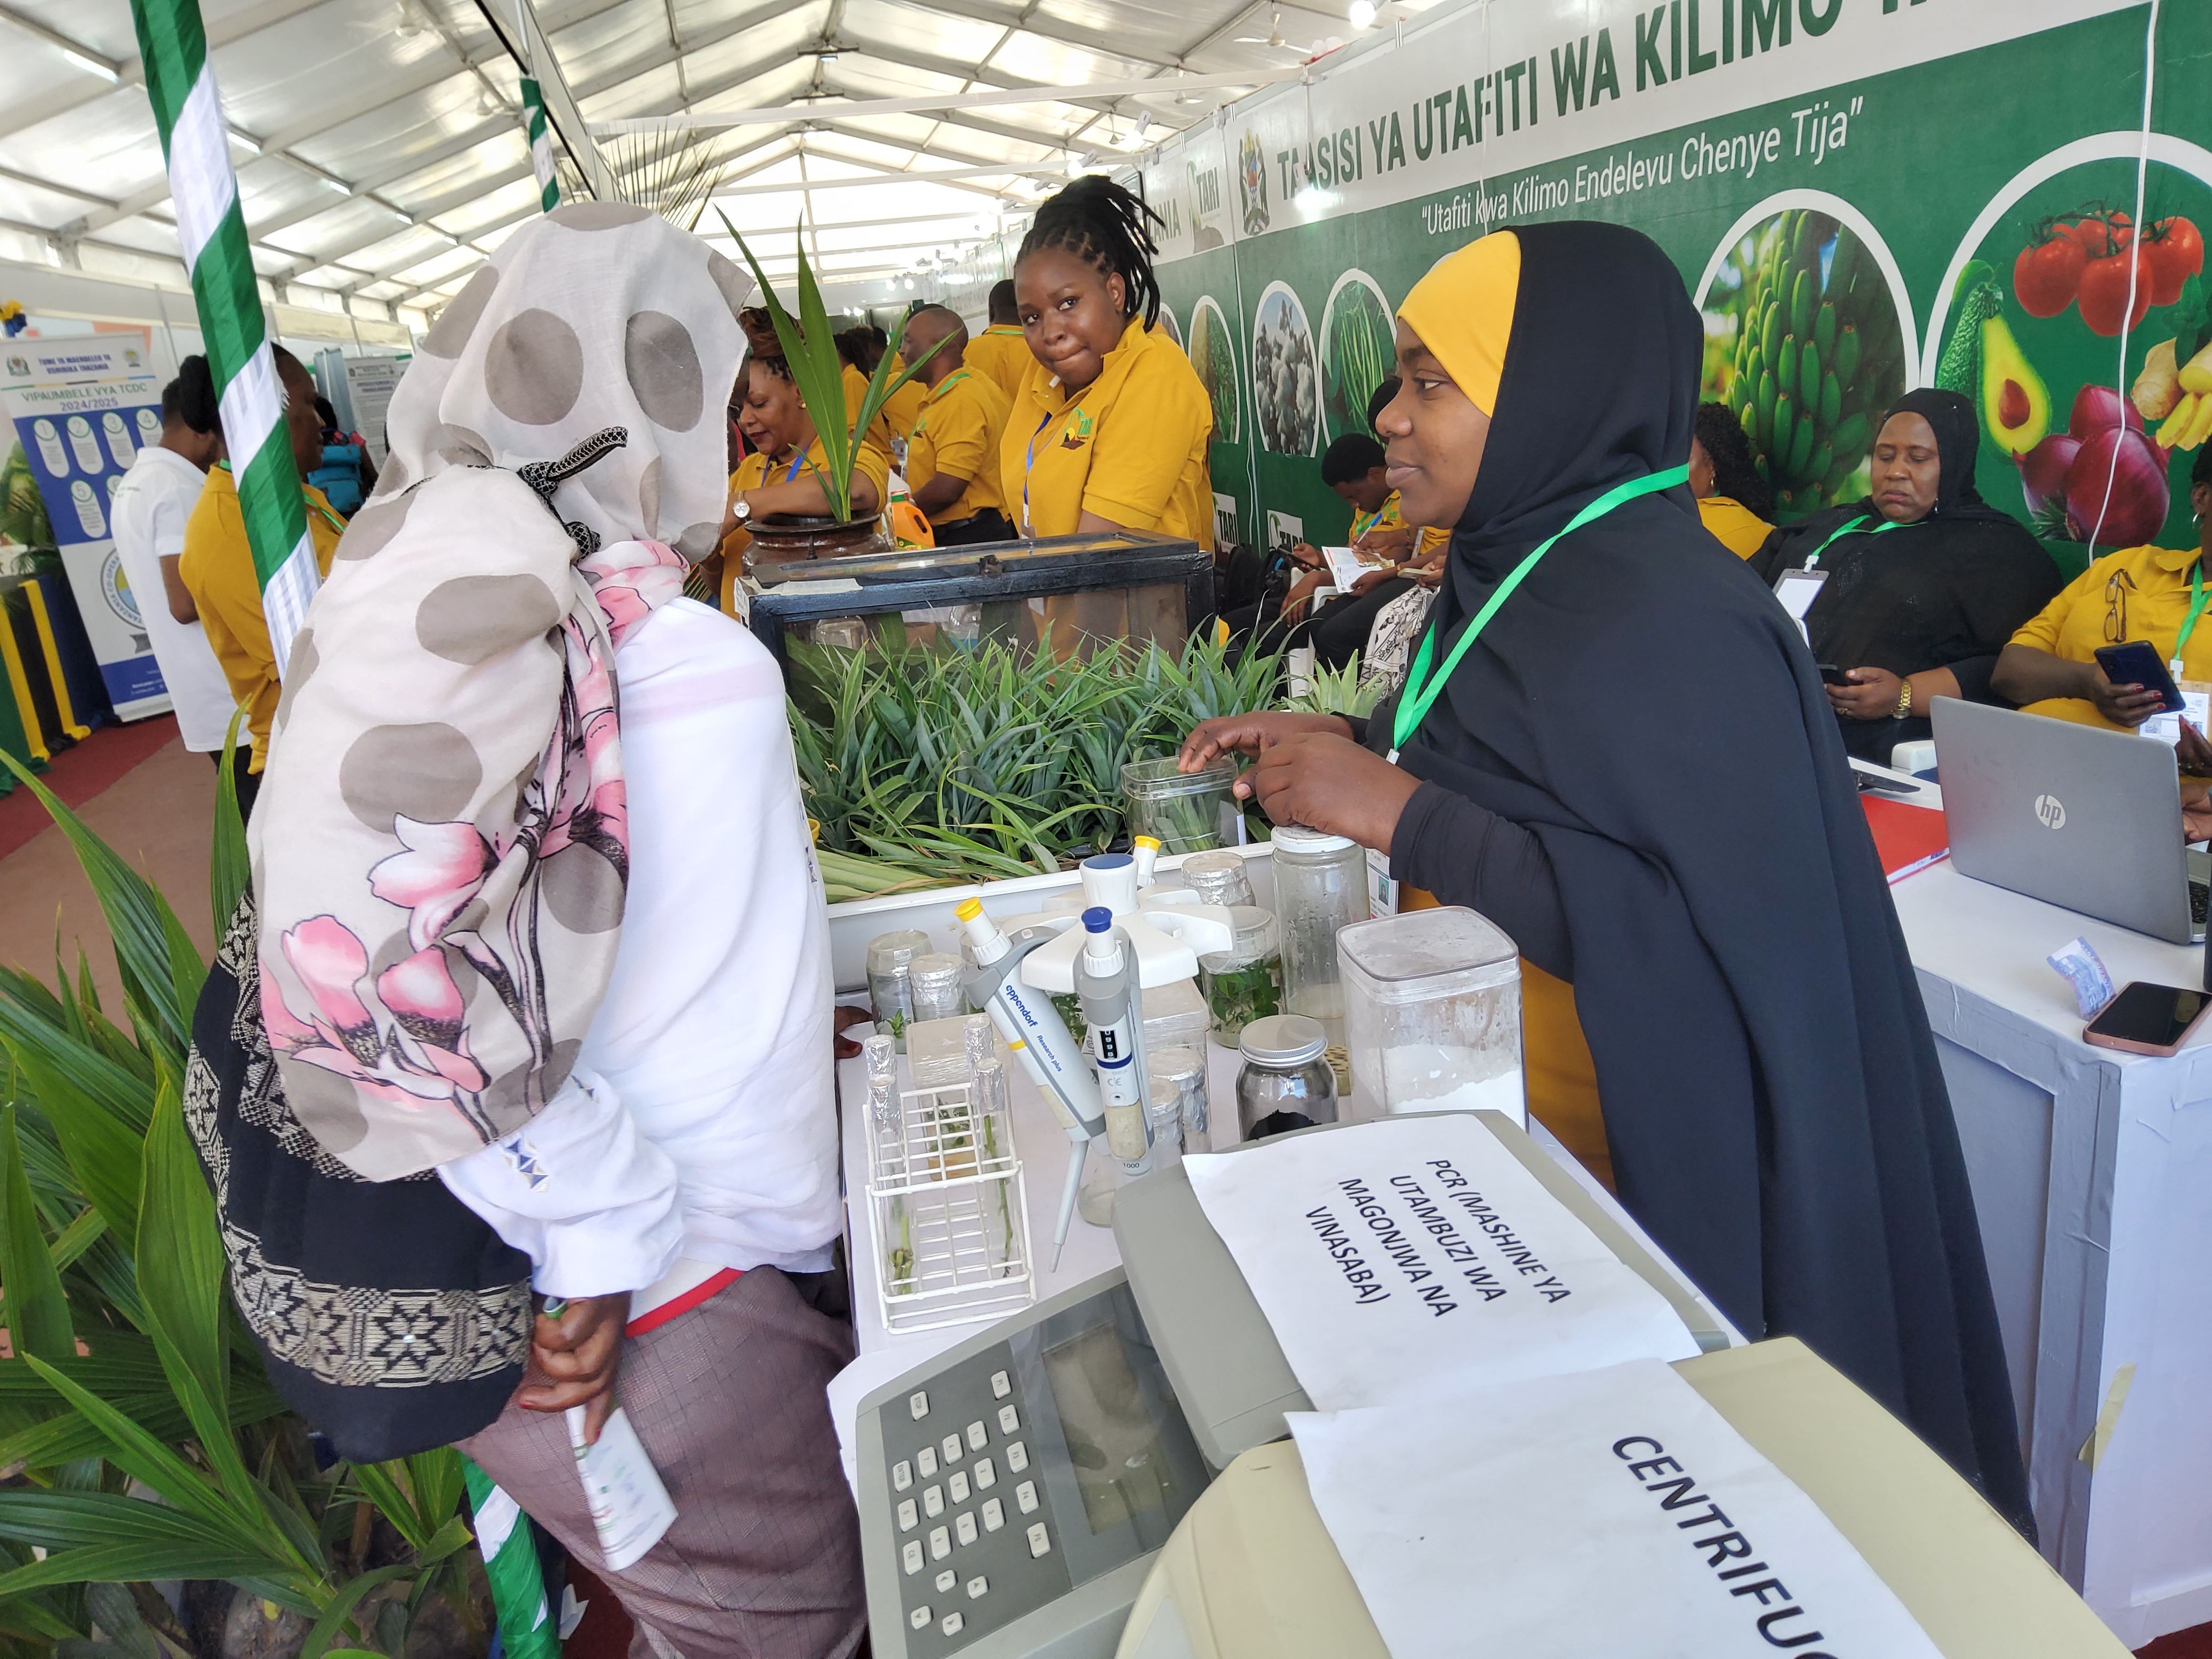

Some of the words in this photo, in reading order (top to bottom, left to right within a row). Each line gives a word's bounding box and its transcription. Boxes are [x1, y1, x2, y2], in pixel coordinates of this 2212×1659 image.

[1369, 111, 1406, 175] YA
[1413, 56, 1538, 161] UTAFITI
[1551, 27, 1620, 117] WA
[1196, 167, 1220, 215] TARI
[1475, 190, 1507, 225] kwa
[1512, 175, 1568, 216] Kilimo
[1574, 151, 1674, 204] Endelevu
[1680, 126, 1781, 180] Chenye
[21, 387, 93, 402] VIPAUMBELE
[95, 386, 117, 396] VYA
[119, 383, 147, 393] TCDC
[60, 398, 118, 412] 2024/2025
[1217, 510, 1239, 546] TARI
[2039, 794, 2061, 829] hp
[1006, 985, 1038, 1027] eppendorf
[1037, 1035, 1055, 1060] Research
[1051, 1057, 1062, 1072] plus
[1337, 1178, 1433, 1283] MAGONJWA
[1417, 1285, 1459, 1318] NA
[1389, 1175, 1478, 1263] UTAMBUZI
[1468, 1266, 1507, 1303] WA
[1426, 1159, 1468, 1190] PCR
[1448, 1190, 1545, 1276] (MASHINE
[1532, 1275, 1572, 1304] YA
[1305, 1205, 1392, 1304] VINASABA)
[914, 1396, 922, 1410] STOP
[1004, 1413, 1011, 1421] F2
[1013, 1451, 1020, 1460] F3
[897, 1464, 905, 1484] ENTER
[1022, 1490, 1029, 1500] F4
[908, 1550, 916, 1560] CE
[1612, 1436, 1840, 1659] CENTRIFU
